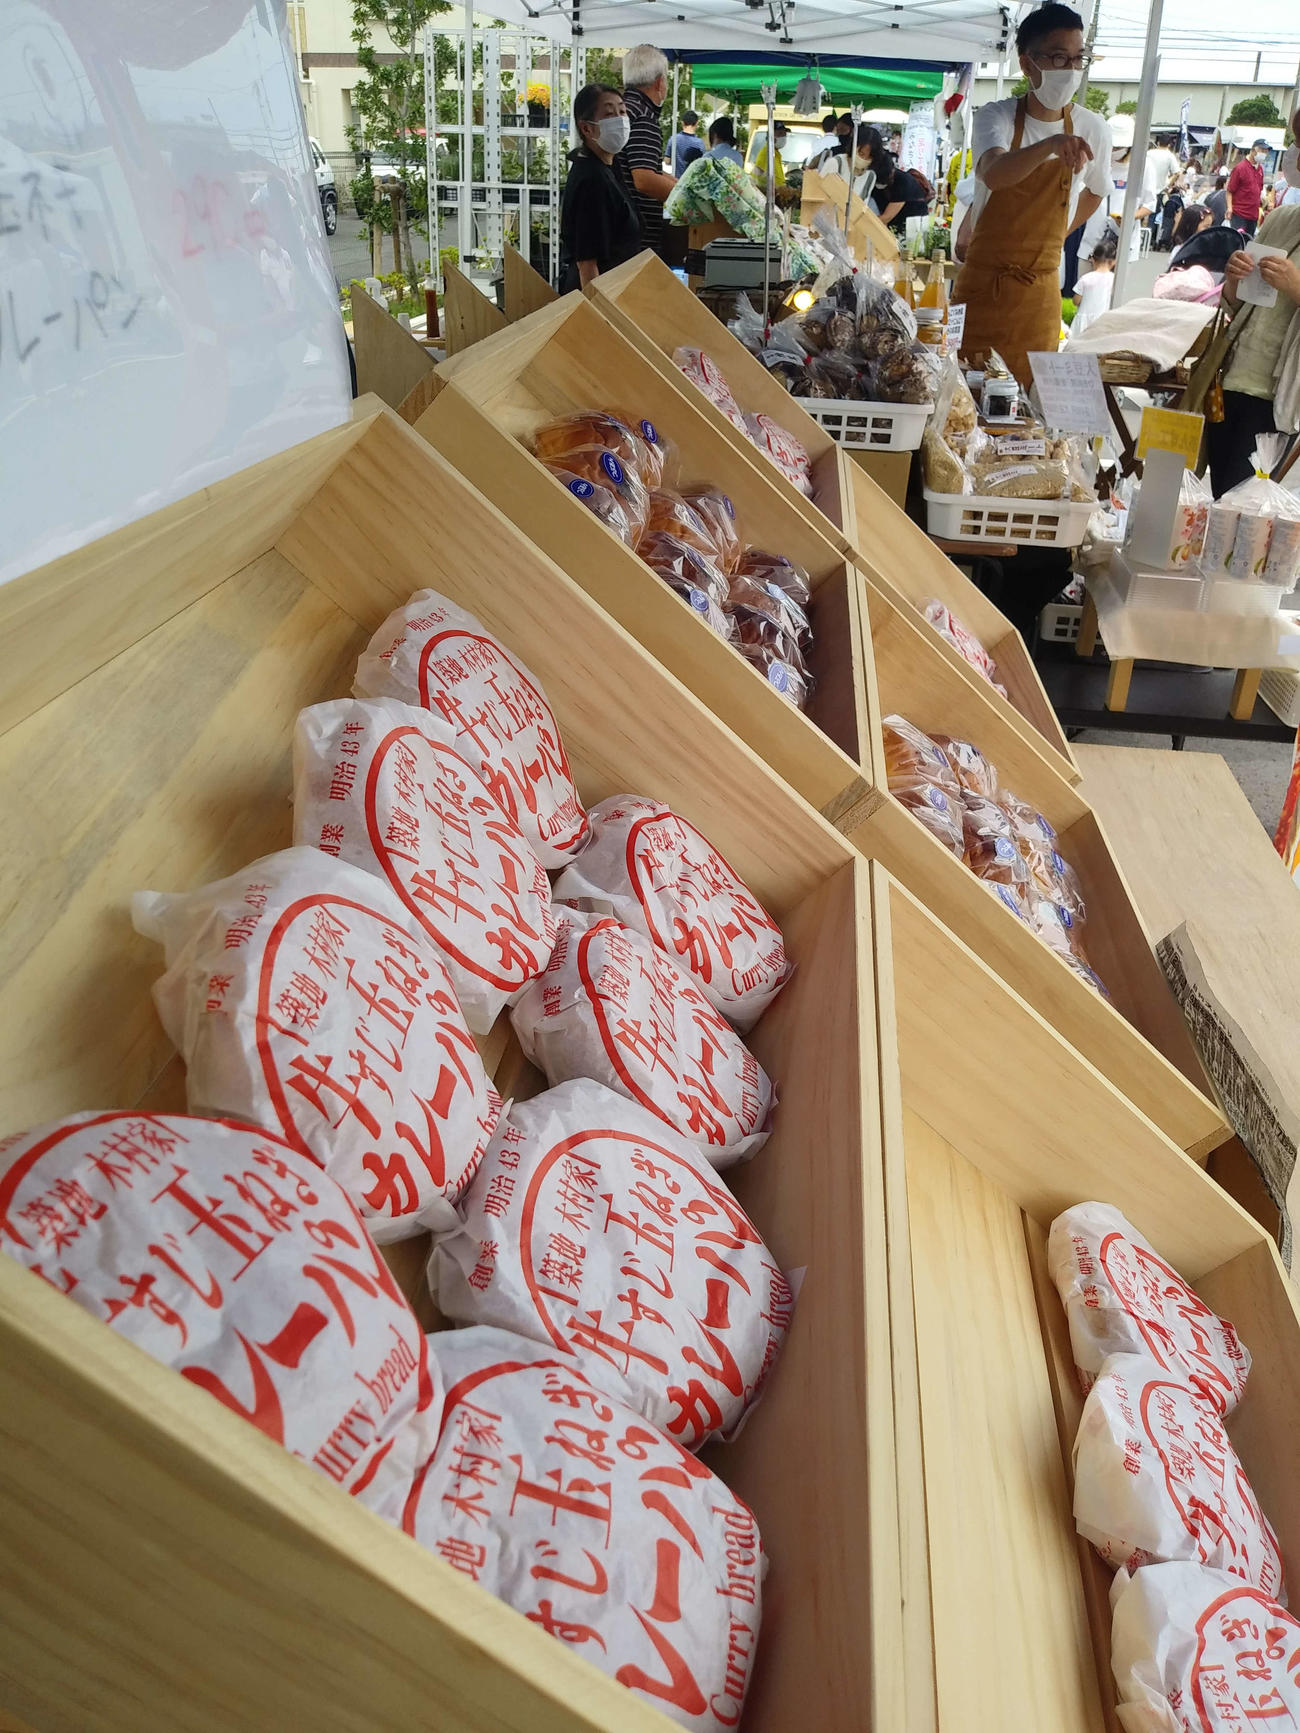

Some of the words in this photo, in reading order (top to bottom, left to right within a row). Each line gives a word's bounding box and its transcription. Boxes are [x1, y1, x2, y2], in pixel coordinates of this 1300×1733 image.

[275, 971, 329, 1032] 築地
[302, 910, 347, 982] 木村家
[731, 967, 770, 997] Curry
[18, 1177, 108, 1258] 築地
[85, 1121, 178, 1191] 木村家
[553, 1158, 602, 1235] 木村家
[539, 1230, 587, 1291] 築地
[311, 1398, 382, 1483] urry
[354, 1323, 420, 1415] bread
[440, 1410, 503, 1527] 木村家
[712, 1505, 757, 1607] bread
[711, 1611, 757, 1727] Curry
